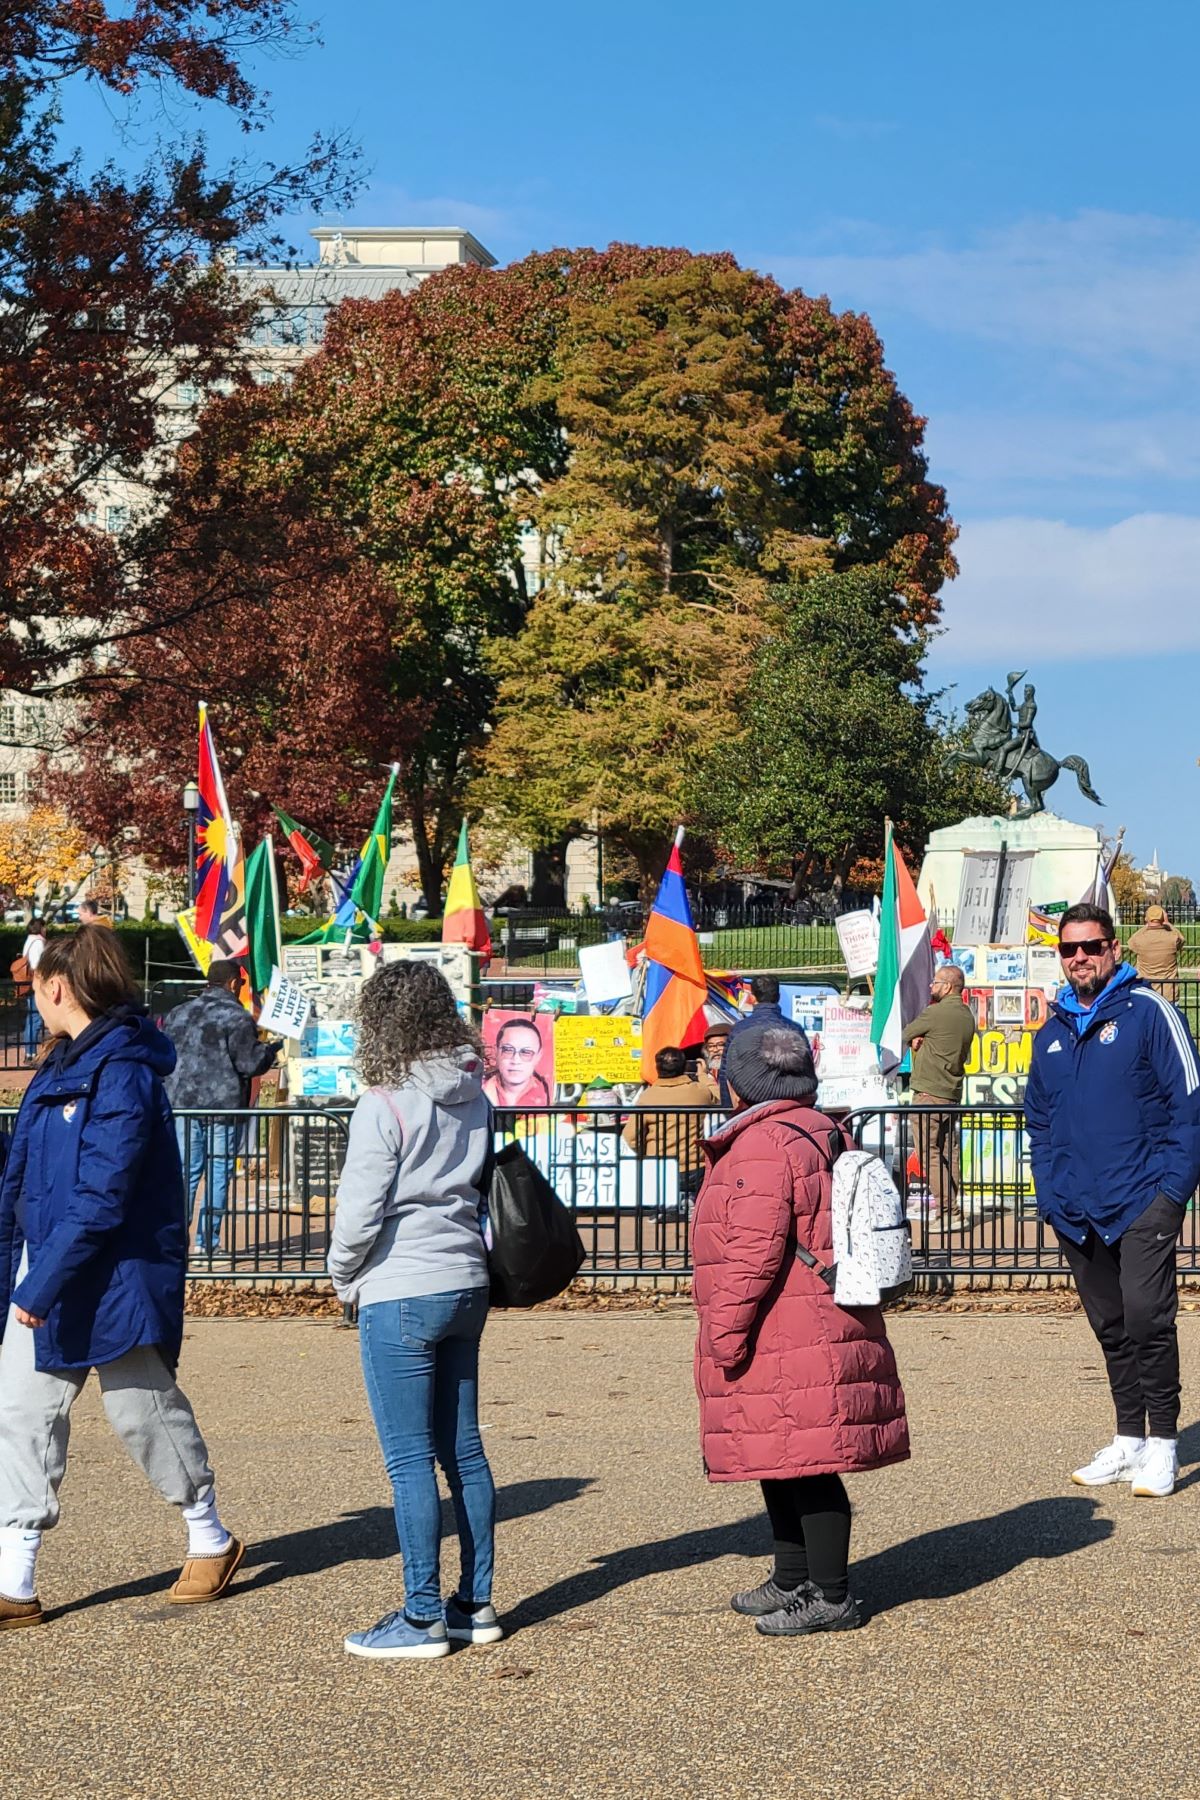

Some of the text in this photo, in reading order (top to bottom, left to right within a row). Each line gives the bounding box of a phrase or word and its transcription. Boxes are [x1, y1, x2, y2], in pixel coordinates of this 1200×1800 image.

[271, 976, 289, 1019] TIBETAN
[284, 988, 298, 1016] LIFES
[838, 1045, 861, 1056] NOW!
[551, 1137, 612, 1157] JEWS
